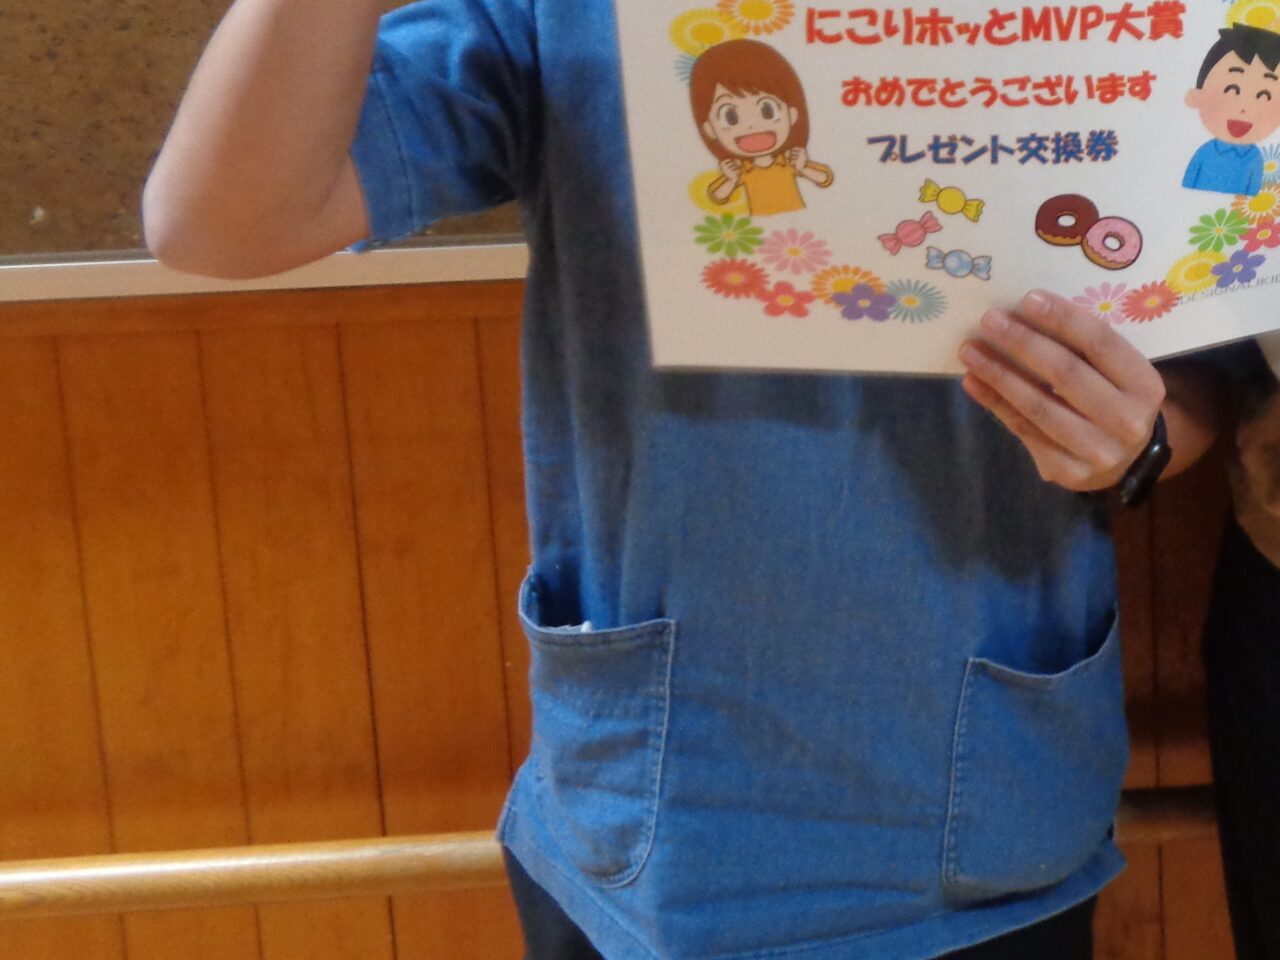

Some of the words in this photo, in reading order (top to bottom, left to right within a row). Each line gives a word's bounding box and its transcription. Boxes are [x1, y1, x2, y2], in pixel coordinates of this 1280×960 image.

[805, 0, 1187, 47] にこりホッとMVP大賞
[841, 71, 1157, 108] おめでとうございます
[867, 130, 1119, 165] プレゼント交換券
